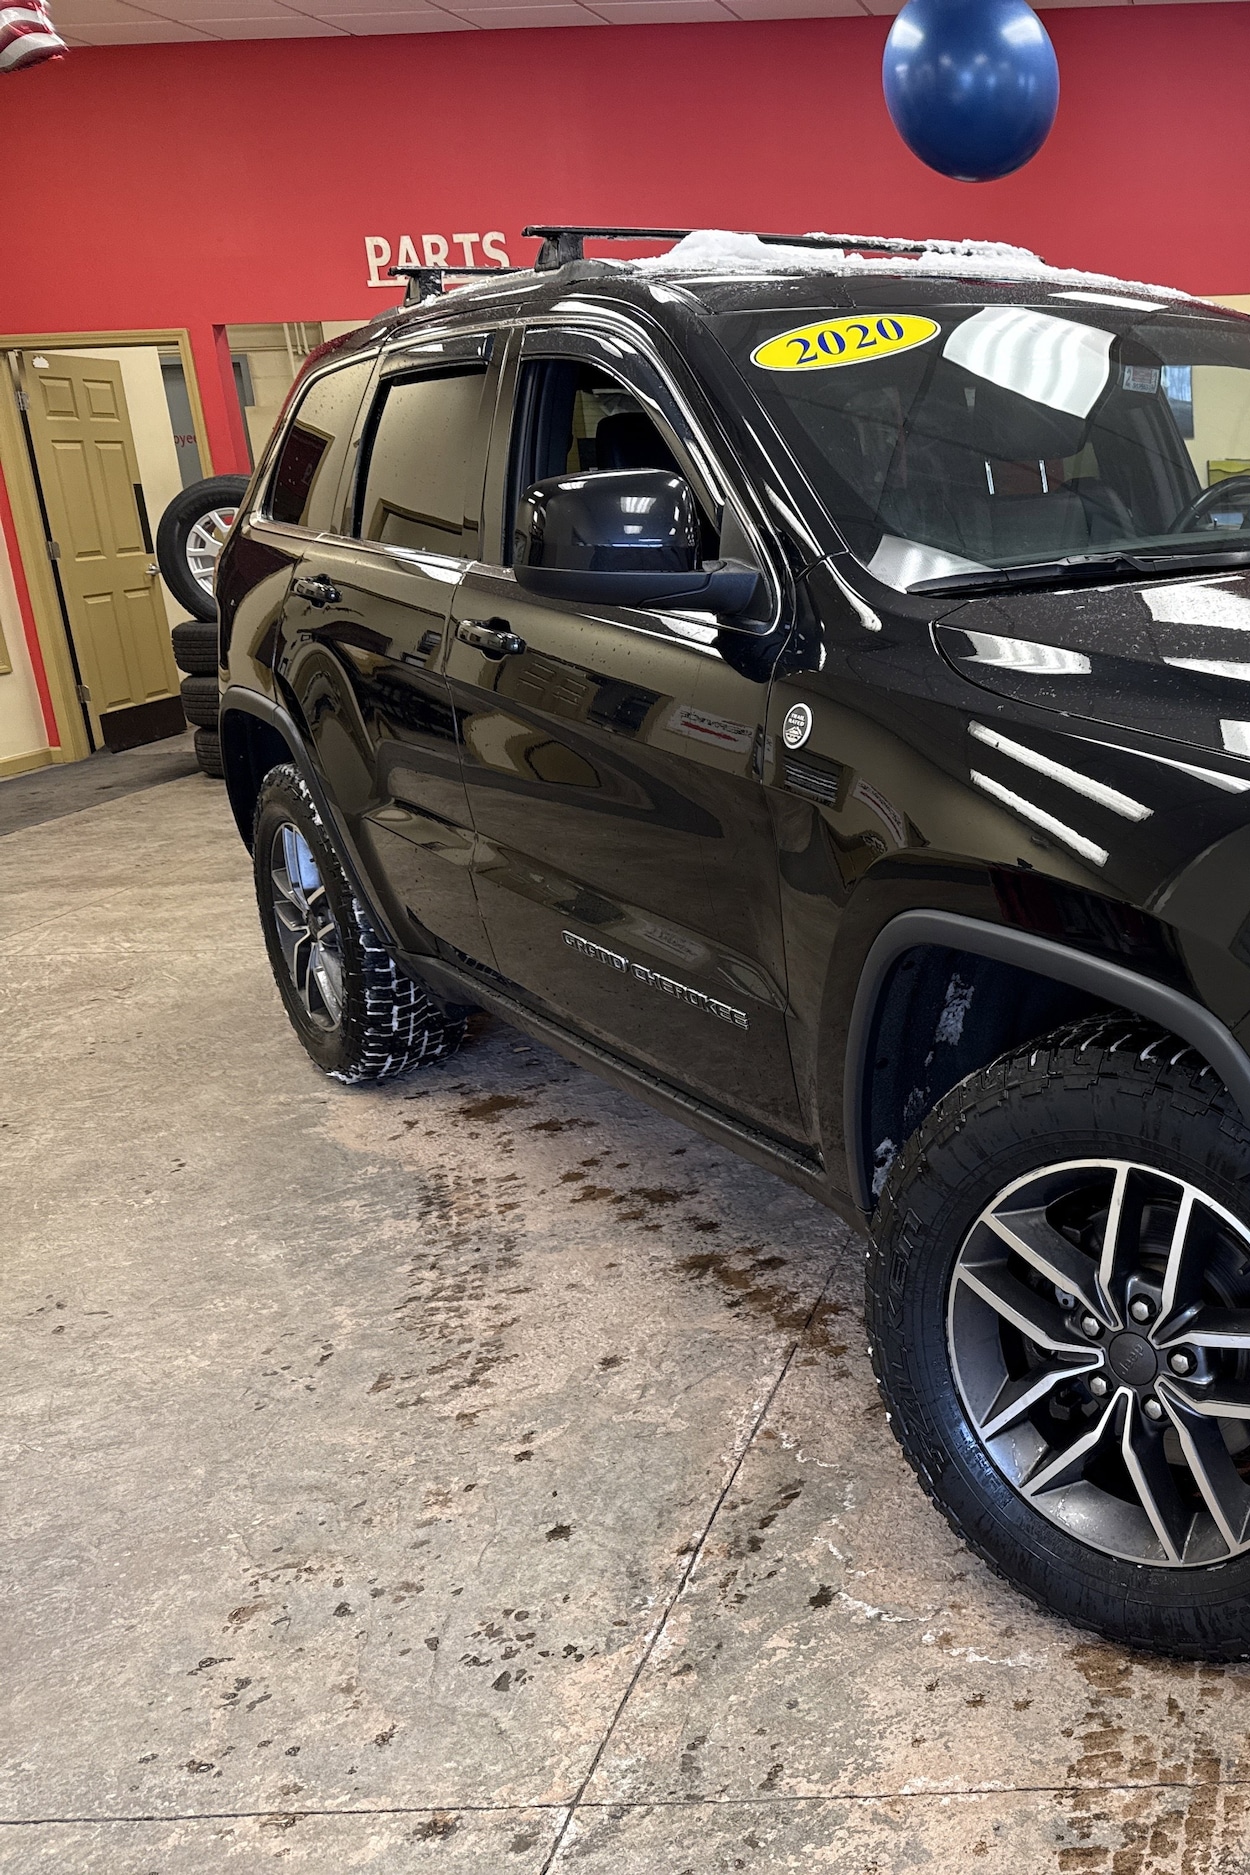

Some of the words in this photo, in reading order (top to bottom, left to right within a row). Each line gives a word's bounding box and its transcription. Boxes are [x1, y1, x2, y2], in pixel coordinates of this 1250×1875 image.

[364, 231, 510, 281] PARTS
[786, 318, 904, 366] 2020
[788, 717, 805, 727] RATED
[791, 713, 805, 721] TRAIL
[561, 930, 628, 973] GRAND
[630, 963, 750, 1031] CHEROKEE
[1119, 1343, 1145, 1376] Jeep
